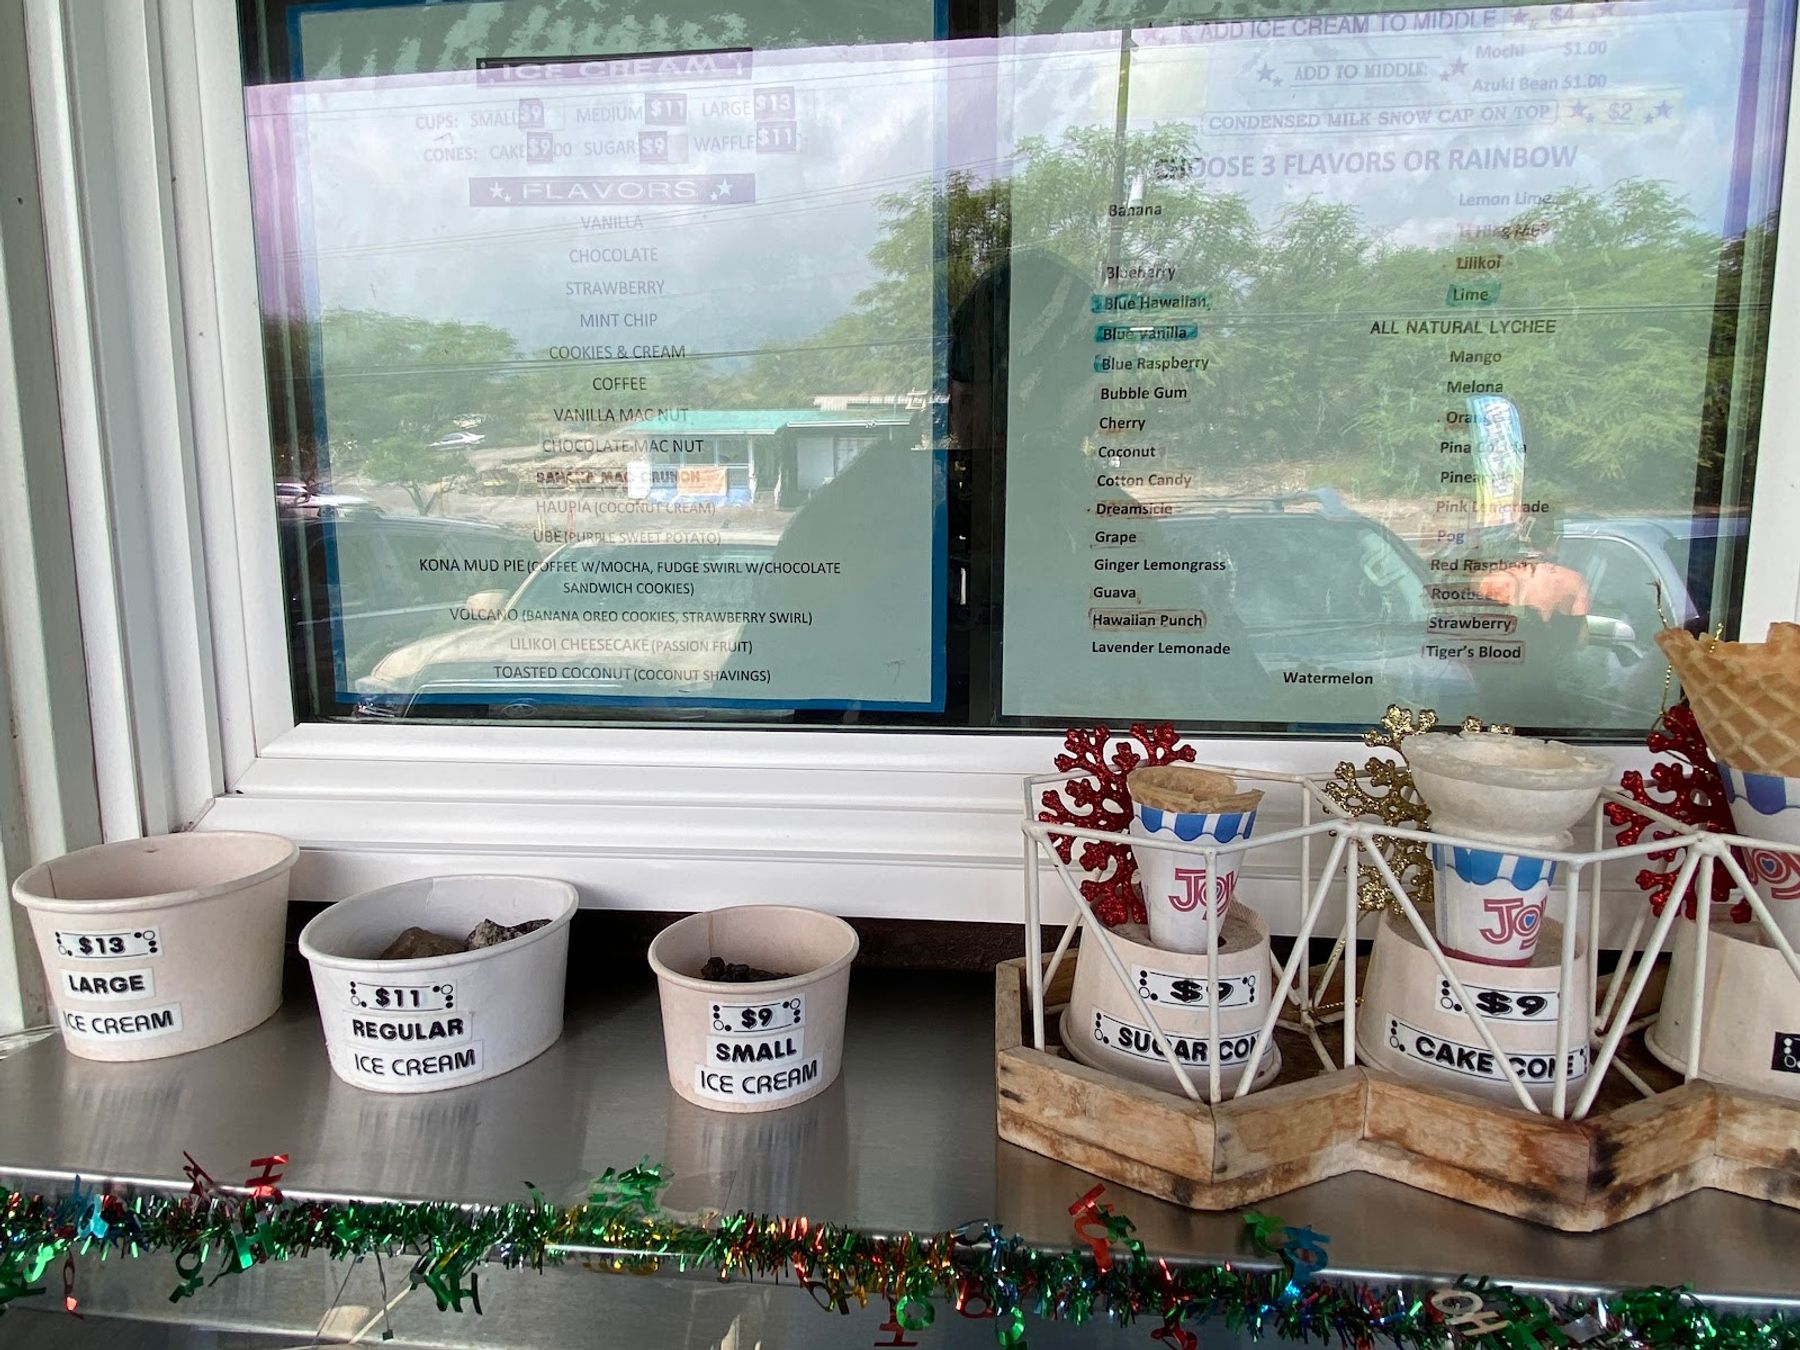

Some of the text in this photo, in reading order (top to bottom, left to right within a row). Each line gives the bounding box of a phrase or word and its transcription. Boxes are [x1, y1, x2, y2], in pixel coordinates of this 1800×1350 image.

[1201, 20, 1244, 40] ADD
[1250, 19, 1288, 38] ICE
[1291, 15, 1369, 37] CREAM
[1377, 13, 1406, 32] TO
[1413, 9, 1496, 31] MIDDLE
[1475, 40, 1608, 60] Mochi $1.00
[1472, 74, 1608, 92] Azuki Bean $1.00
[415, 113, 459, 131] CUPS:
[576, 105, 643, 124] MEDIUM
[650, 97, 685, 119] $11
[702, 99, 752, 118] LARGE
[755, 93, 791, 113] $13
[1208, 102, 1632, 131] CONDENSED MILK SNOW CAP ON TOP $2
[424, 146, 478, 163] CONES:
[694, 133, 755, 152] WAFFLE
[1261, 145, 1579, 177] 3 FLAVORS OR RAINBOW
[522, 180, 698, 200] FLAVORS
[1458, 191, 1553, 207] Lemon Lime
[1109, 204, 1162, 217] Banana
[580, 214, 644, 230] VANILLA
[568, 246, 659, 264] CHOCOLATE
[1456, 255, 1502, 270] Lilikoi
[565, 278, 665, 297] STRAWBERRY
[1453, 287, 1489, 302] Lime
[1104, 297, 1136, 310] Blue
[579, 312, 658, 329] MINT CHIP
[1370, 319, 1557, 336] ALL NATURAL LYCHEE
[1103, 328, 1134, 341] Blue
[549, 344, 686, 361] COOKIES & CREAM
[1449, 350, 1502, 366] Mango
[1102, 355, 1210, 372] Blue Raspberry
[592, 376, 648, 392] COFFEE
[1100, 385, 1188, 400] Bubble Gum
[1446, 380, 1504, 394] Melona
[553, 407, 689, 423] VANILLA MAC NUT
[1099, 415, 1146, 434] Cherry
[541, 438, 704, 454] CHOCOLATE MAC NUT
[1097, 445, 1156, 459] Coconut
[1440, 441, 1472, 454] Pina
[1096, 473, 1192, 490] Cotton Candy
[536, 500, 716, 516] HAUPIA (COCONUT CREAM)
[1436, 500, 1468, 513] Pink
[533, 530, 562, 544] UBE
[618, 531, 663, 545] SWEET
[665, 531, 722, 547] POTATO)
[1095, 530, 1137, 547] Grape
[1437, 529, 1465, 545] Pog
[419, 558, 841, 577] KONA MUD PIE (COFFEE W/MOCHA, FUDGE SWIRL W/CHOCOLATE
[1094, 558, 1226, 575] Ginger Lemongrass
[1430, 559, 1459, 571] Red
[562, 581, 695, 598] SANDWICH COOKIES)
[1092, 586, 1137, 600] Guava
[449, 607, 813, 627] VOLCANO (BANANA OREO COOKIES, STRAWBERRY SWIRL)
[1092, 613, 1203, 627] Hawaiian Punch
[1428, 616, 1512, 632] Strawberry
[509, 637, 753, 656] LILIKOI CHEESECAKE (PASSION FRUIT)
[1091, 641, 1231, 656] Lavender Lemonade
[1425, 644, 1522, 660] Tiger's Blood
[493, 665, 771, 684] TOASTED COCONUT (COCONUT SHAVINGS)
[1282, 671, 1374, 685] Watermelon
[78, 934, 126, 957] $13
[68, 973, 145, 995] LARGE
[374, 985, 422, 1009] $11
[1475, 990, 1549, 1016] $9
[62, 1009, 175, 1035] ICE CREAM
[740, 1007, 773, 1030] $9
[352, 1017, 465, 1041] REGULAR
[714, 1037, 798, 1064] SMALL
[1218, 1034, 1260, 1060] CON
[1415, 1036, 1496, 1075] CAKE
[354, 1048, 477, 1077] ICE CREAM
[700, 1062, 819, 1097] ICE CREAM
